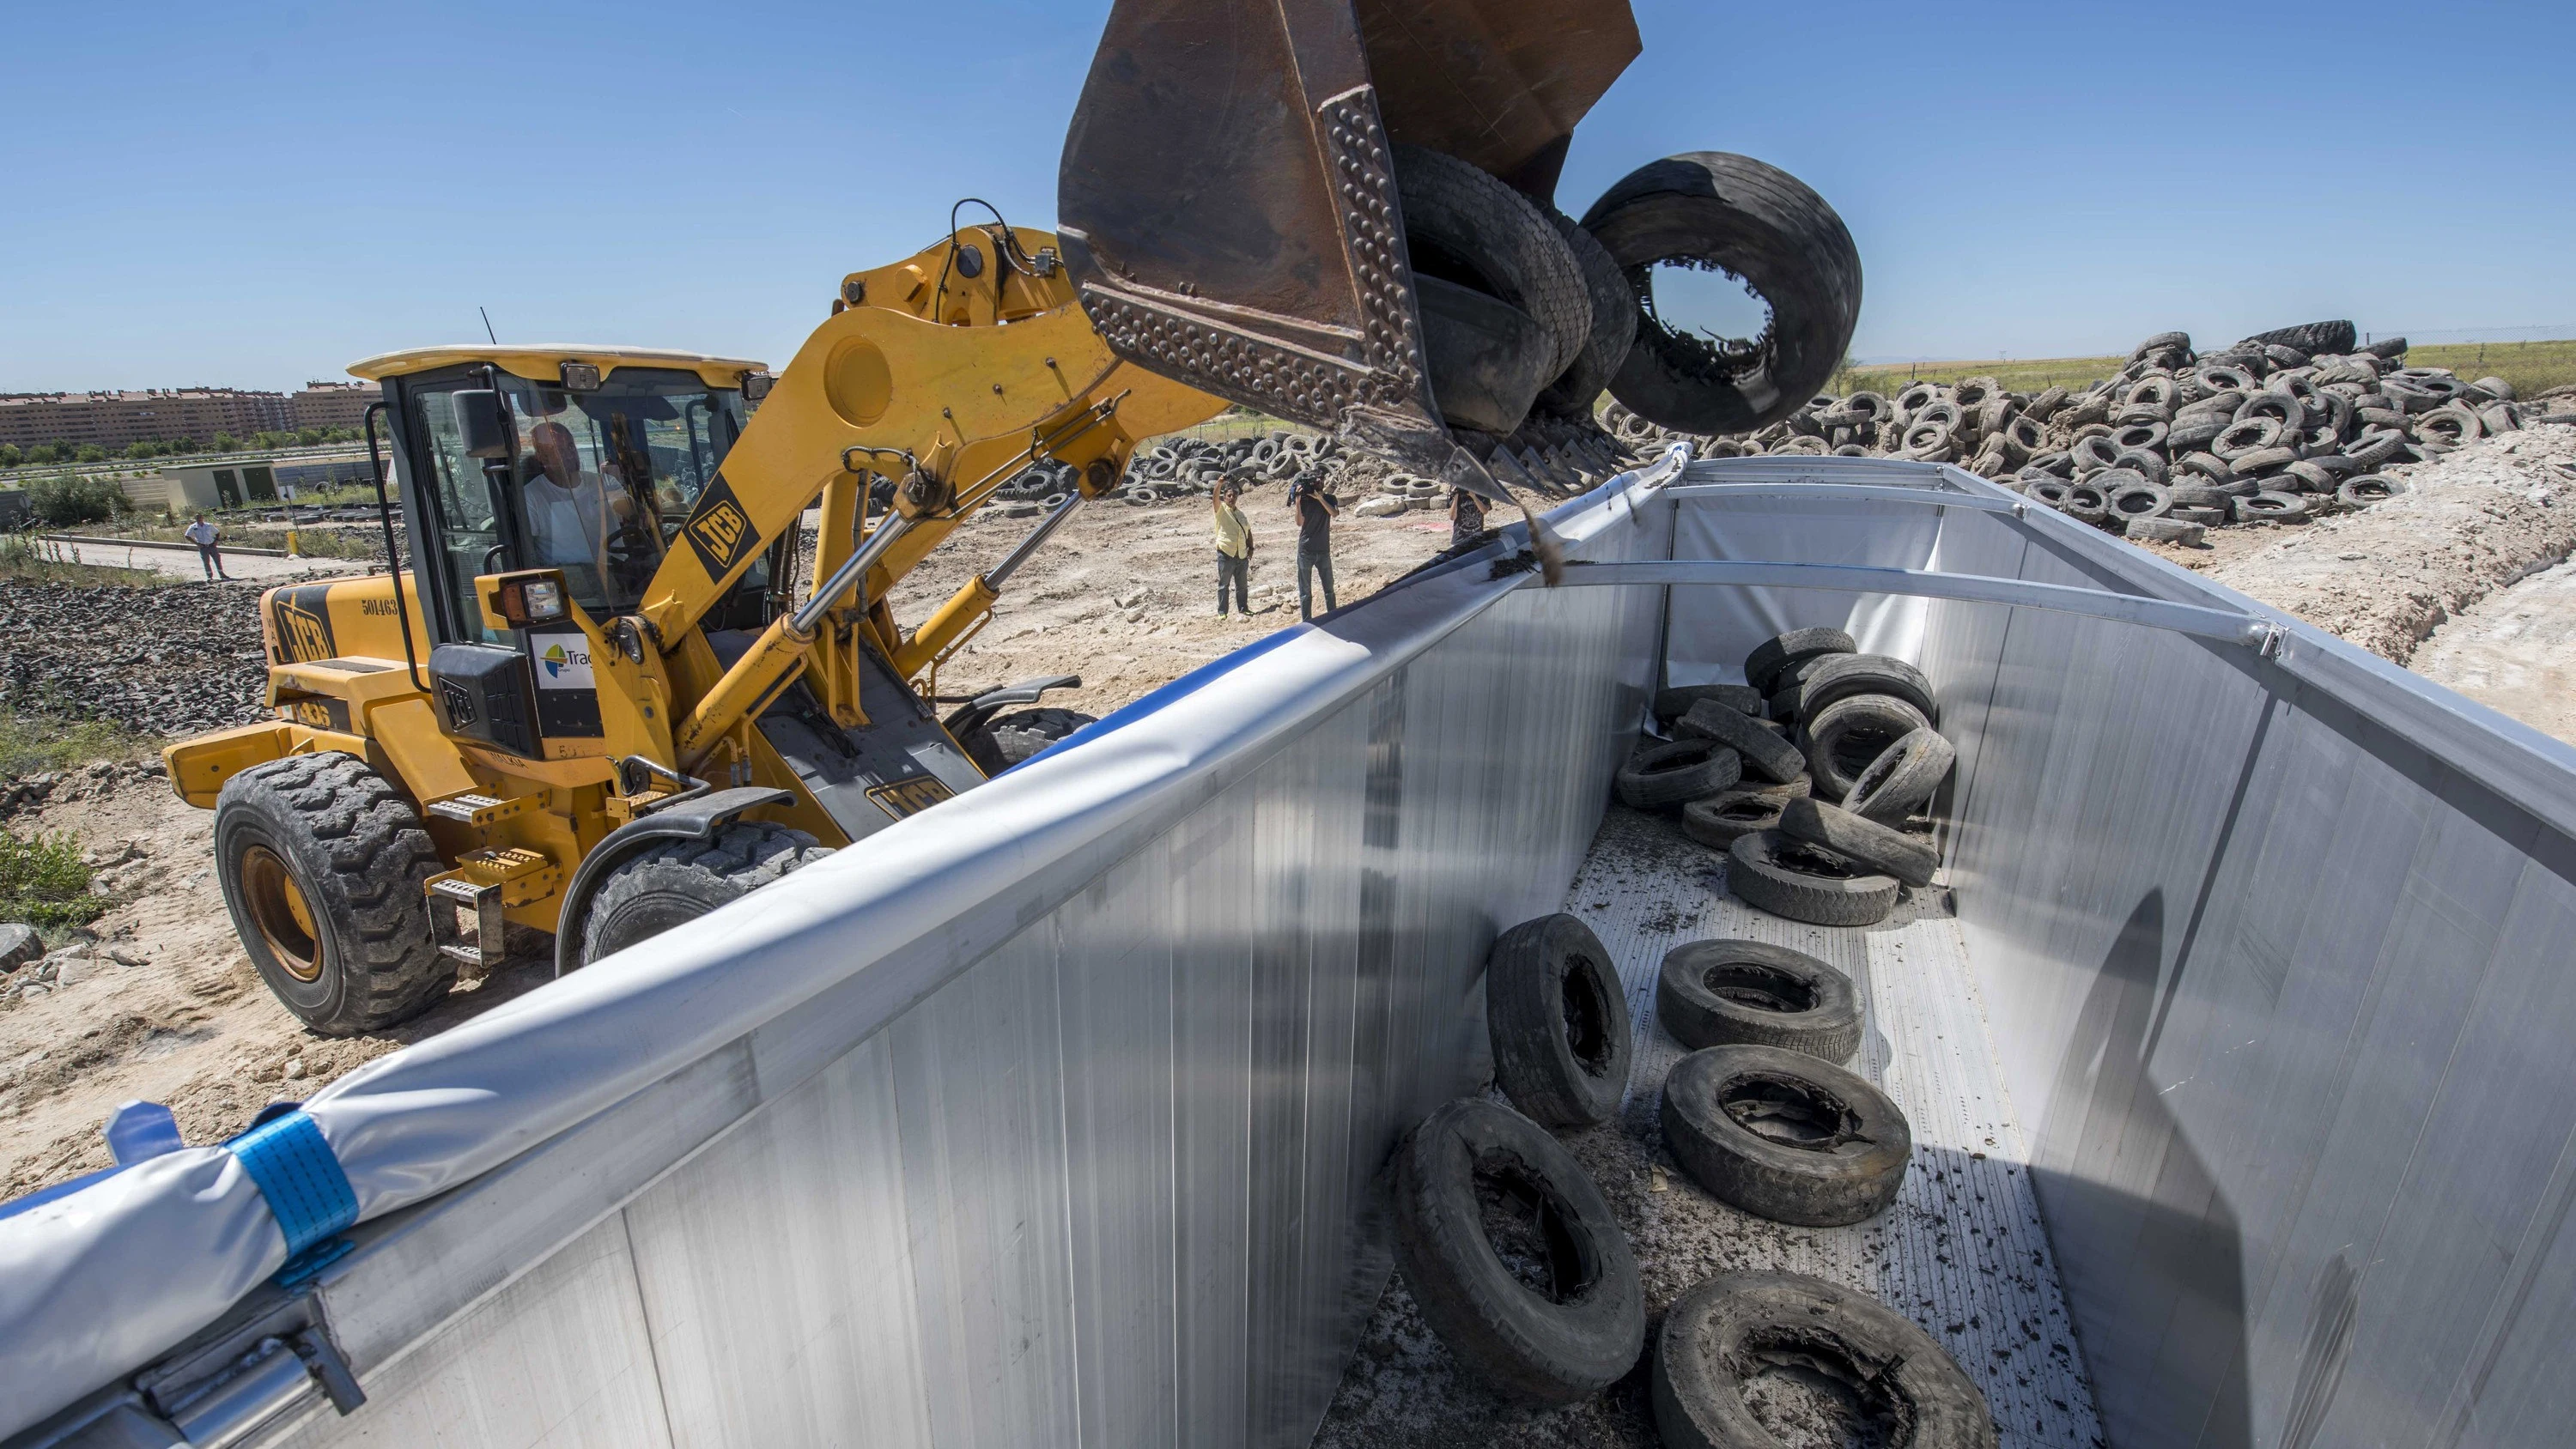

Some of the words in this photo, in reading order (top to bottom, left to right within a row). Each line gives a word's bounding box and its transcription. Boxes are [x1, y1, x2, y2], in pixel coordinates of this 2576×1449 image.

[696, 506, 742, 562] JCB
[361, 598, 398, 615] 501463
[284, 609, 330, 663] JCB
